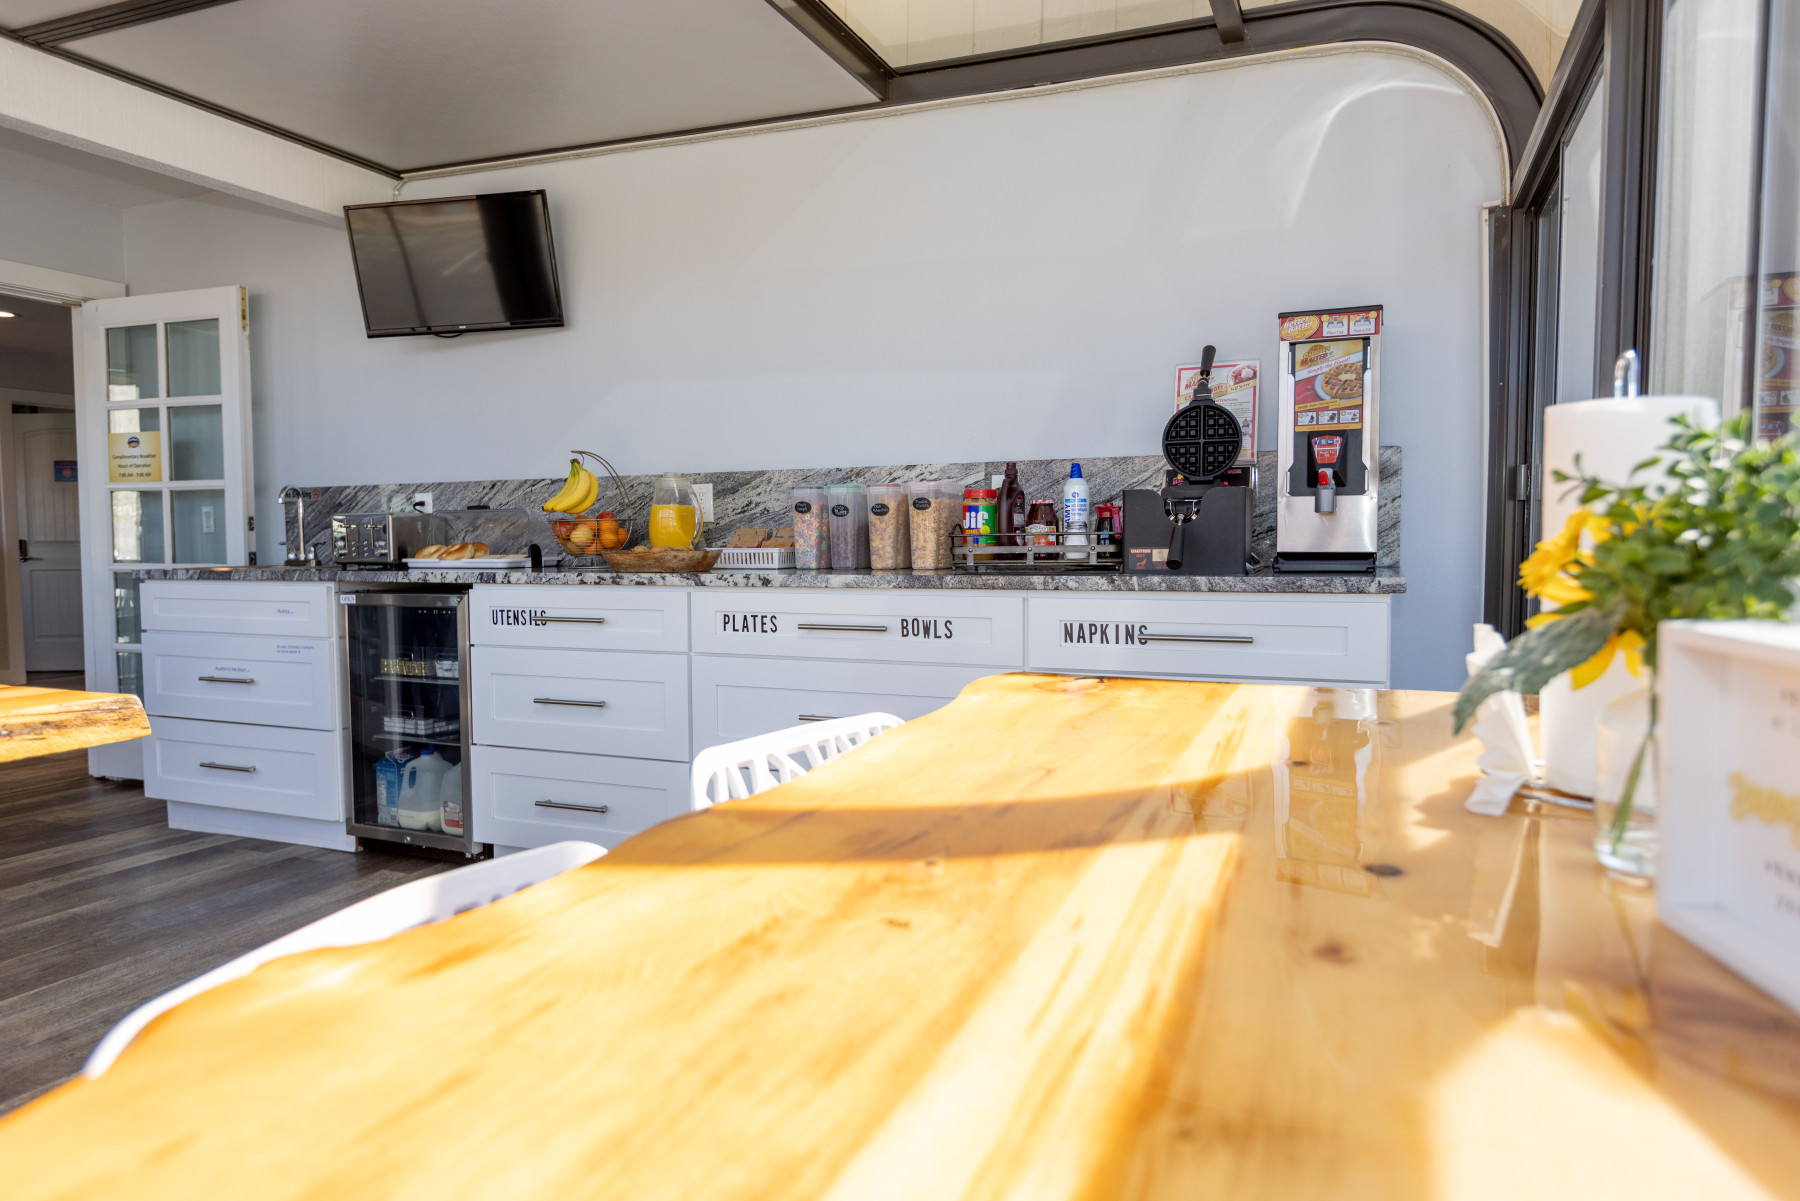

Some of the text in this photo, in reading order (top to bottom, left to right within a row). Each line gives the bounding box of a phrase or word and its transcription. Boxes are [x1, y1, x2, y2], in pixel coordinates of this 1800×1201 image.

[1306, 364, 1325, 374] Simply
[963, 511, 988, 529] Jif
[492, 609, 547, 626] UTENSILS
[723, 613, 954, 640] PLATES BOWLS
[1063, 622, 1148, 646] NAPKINS
